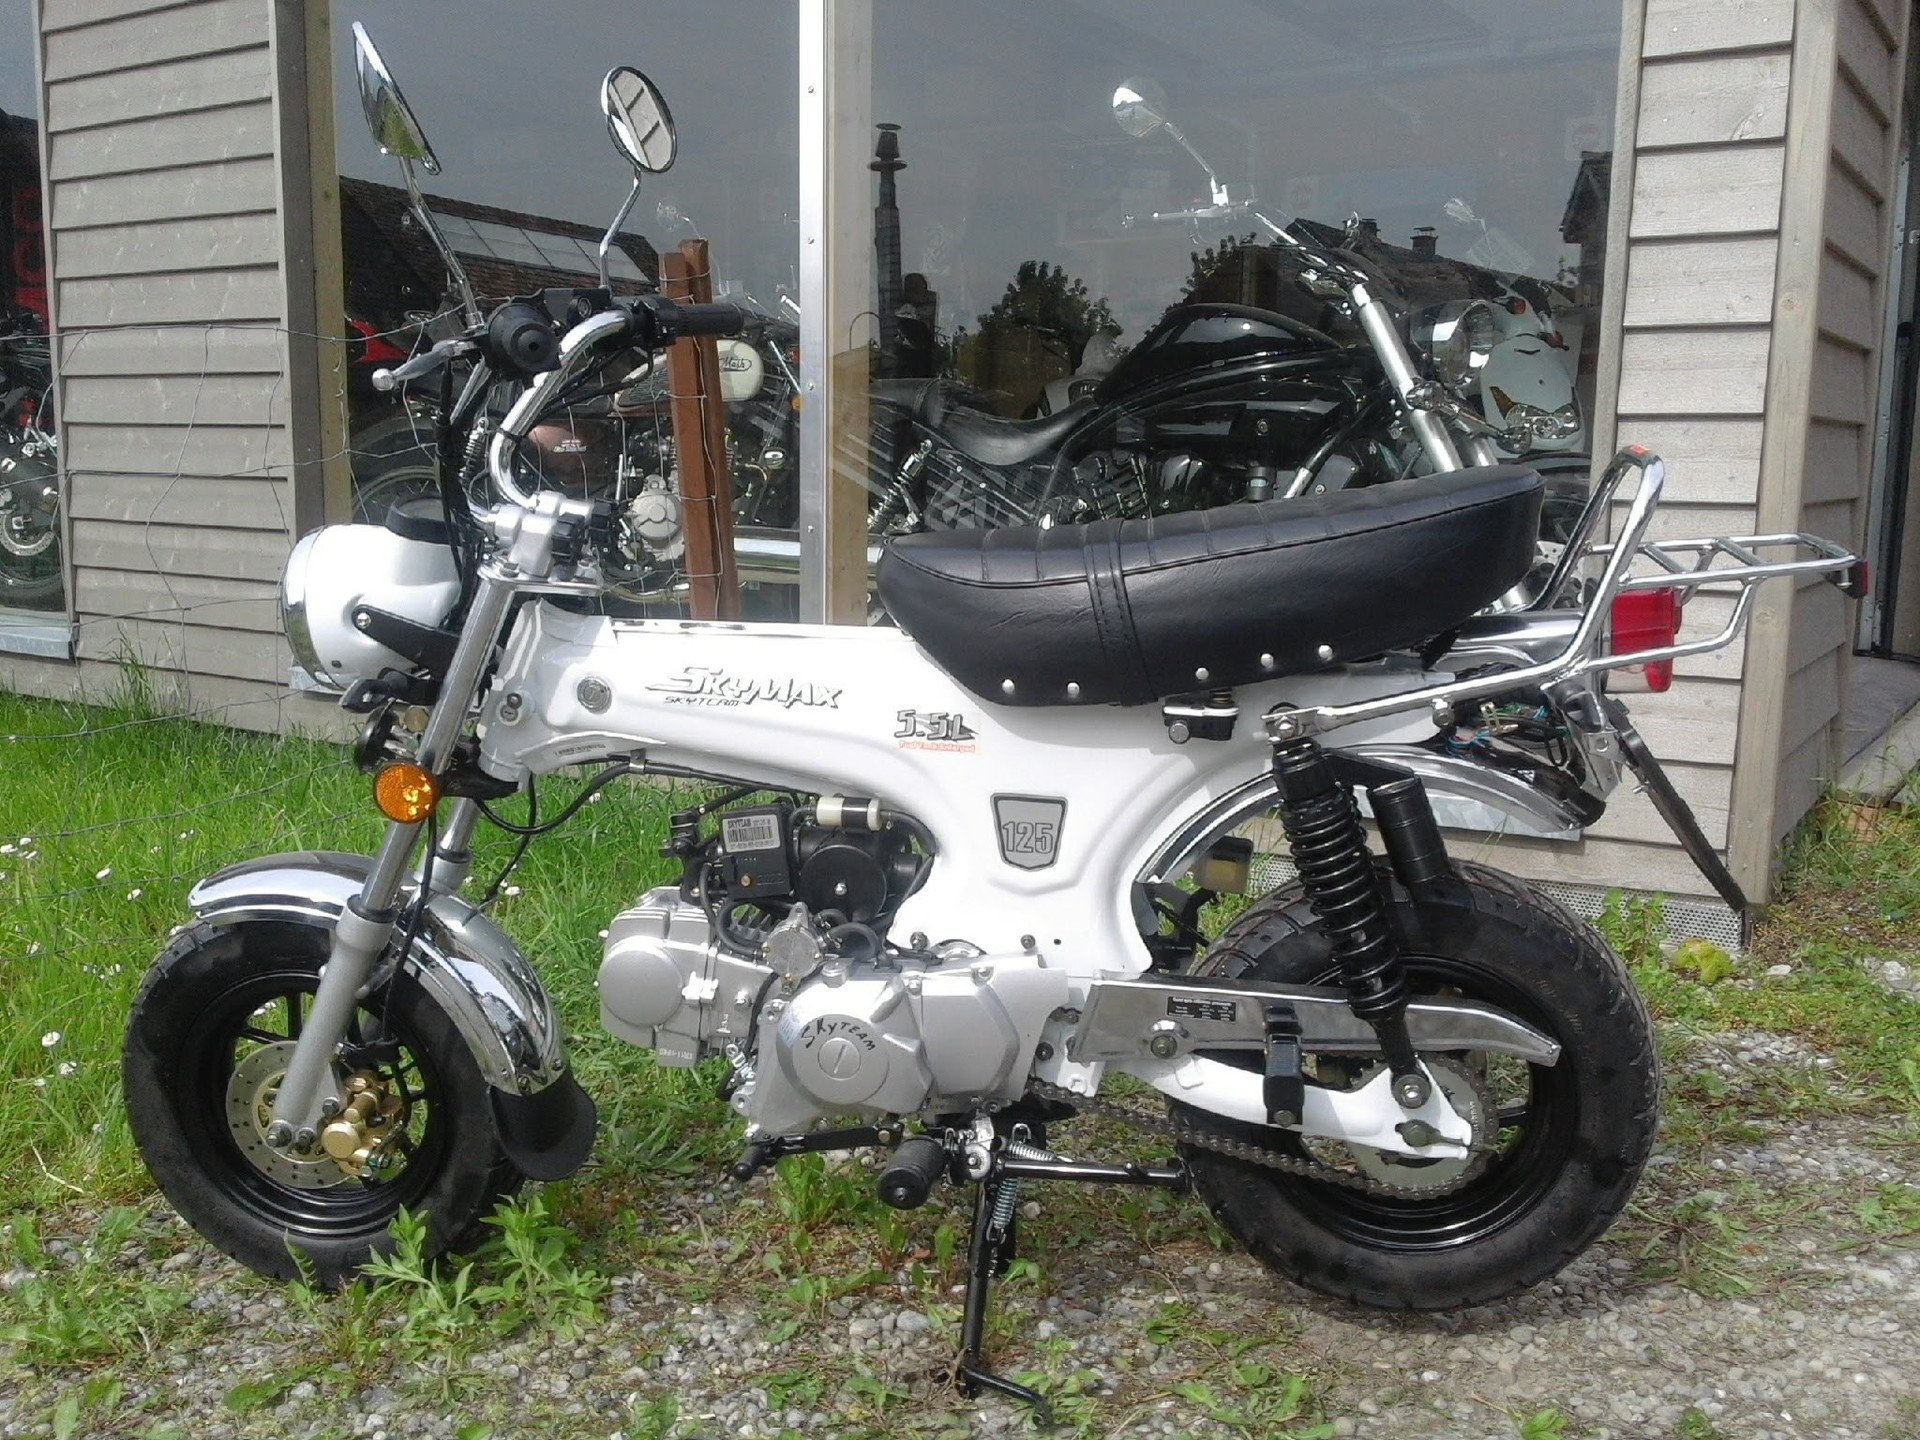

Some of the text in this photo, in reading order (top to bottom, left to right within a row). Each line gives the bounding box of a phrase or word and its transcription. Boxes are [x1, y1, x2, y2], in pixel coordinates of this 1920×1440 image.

[894, 709, 978, 741] 5.5L
[1002, 821, 1054, 855] 125
[801, 1018, 876, 1050] SKYTEAM
